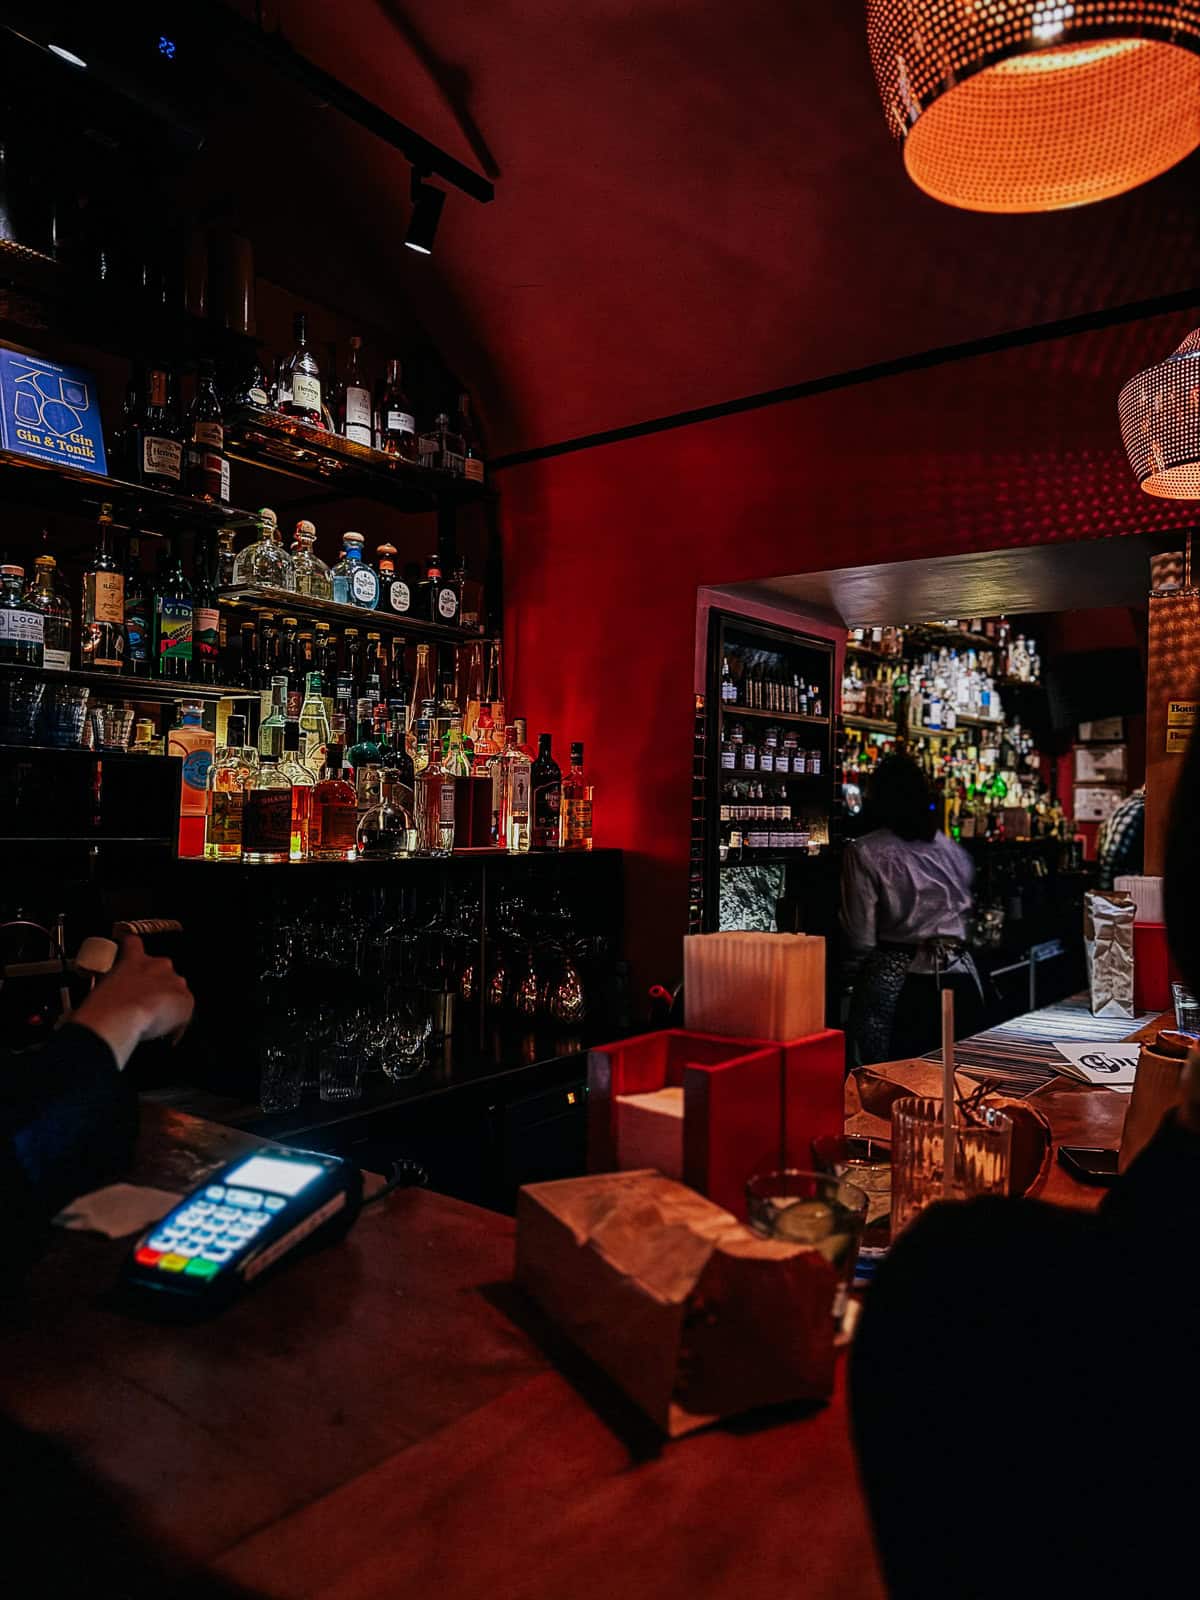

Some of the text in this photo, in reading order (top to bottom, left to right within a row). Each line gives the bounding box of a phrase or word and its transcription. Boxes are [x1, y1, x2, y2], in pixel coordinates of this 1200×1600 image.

[16, 428, 95, 458] Gin & Tonik
[69, 432, 94, 447] Gin
[12, 615, 42, 626] LOCAL
